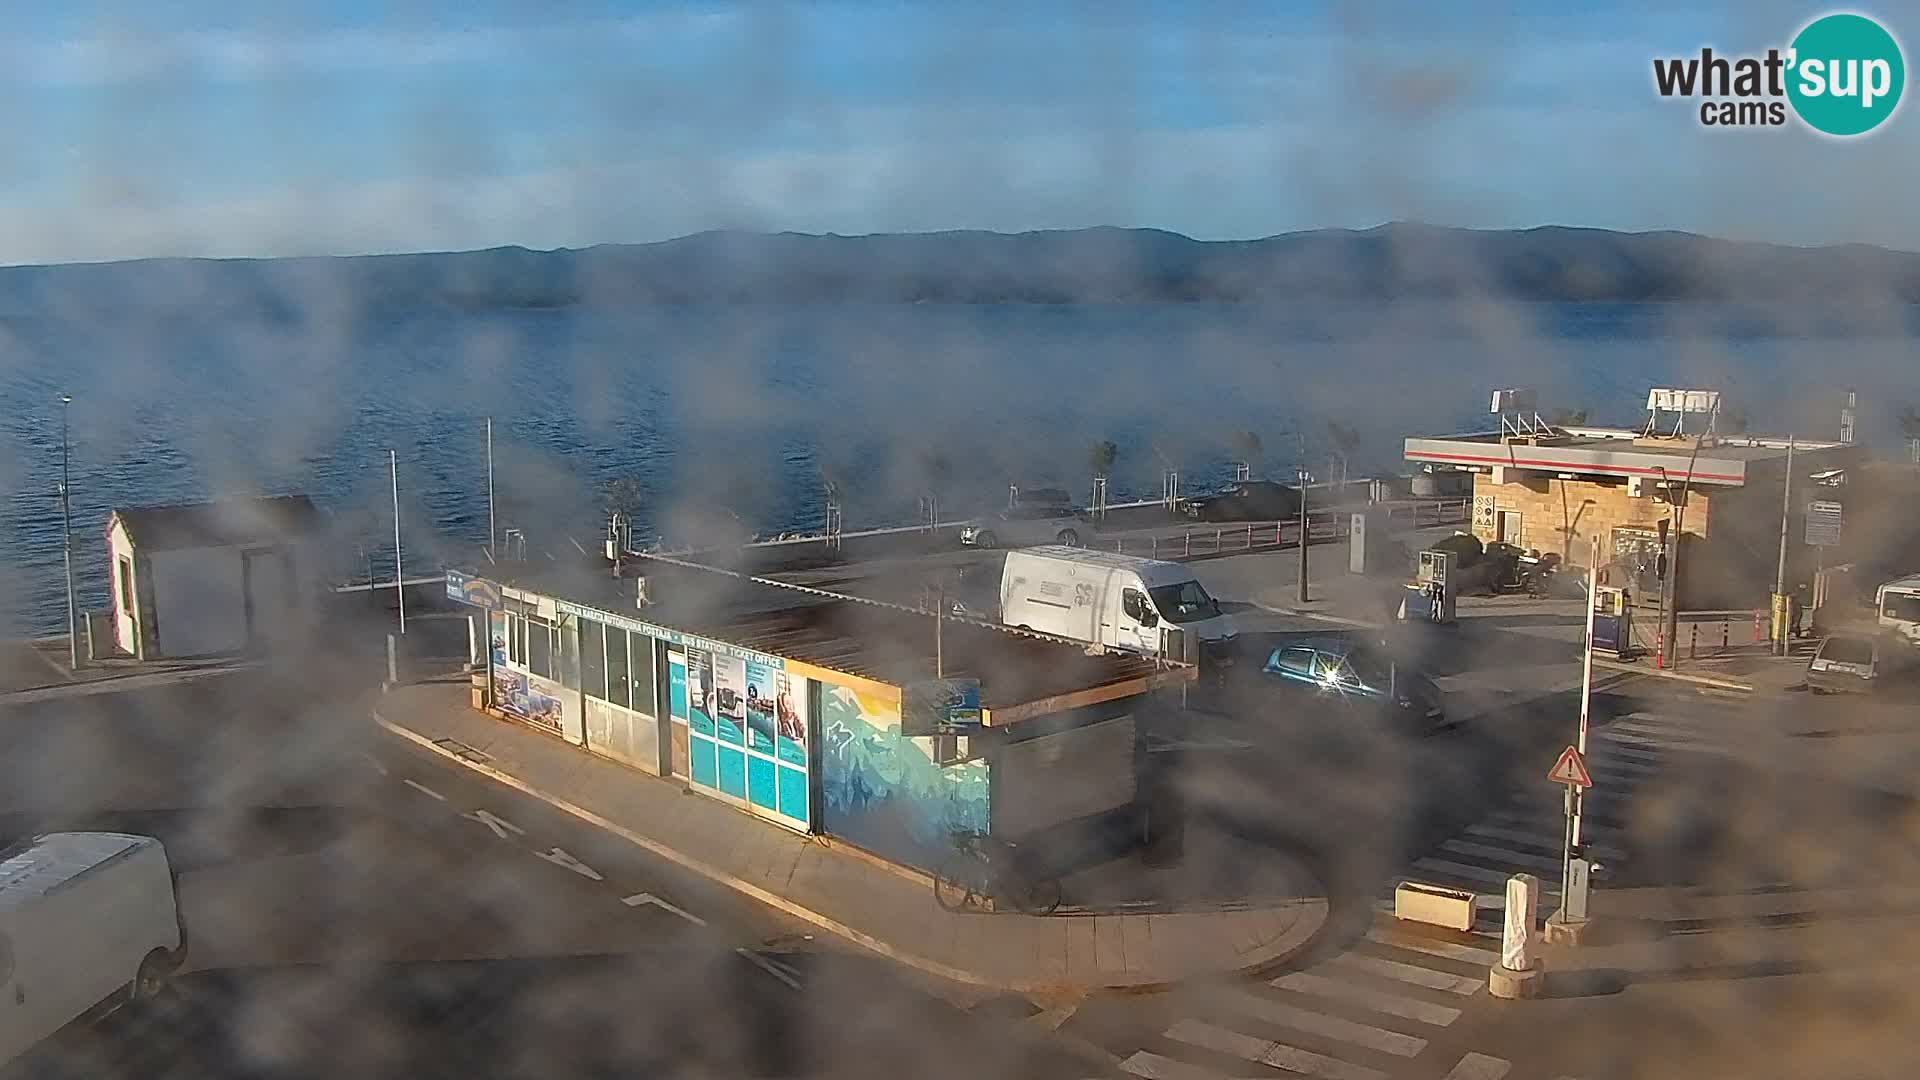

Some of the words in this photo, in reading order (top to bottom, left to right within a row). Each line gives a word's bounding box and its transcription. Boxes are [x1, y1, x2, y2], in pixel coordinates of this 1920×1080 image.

[642, 624, 672, 640] POSTAJA
[681, 635, 695, 648] BUS
[696, 638, 727, 655] STATION
[729, 647, 754, 662] TICKET
[754, 653, 781, 669] OFFICE
